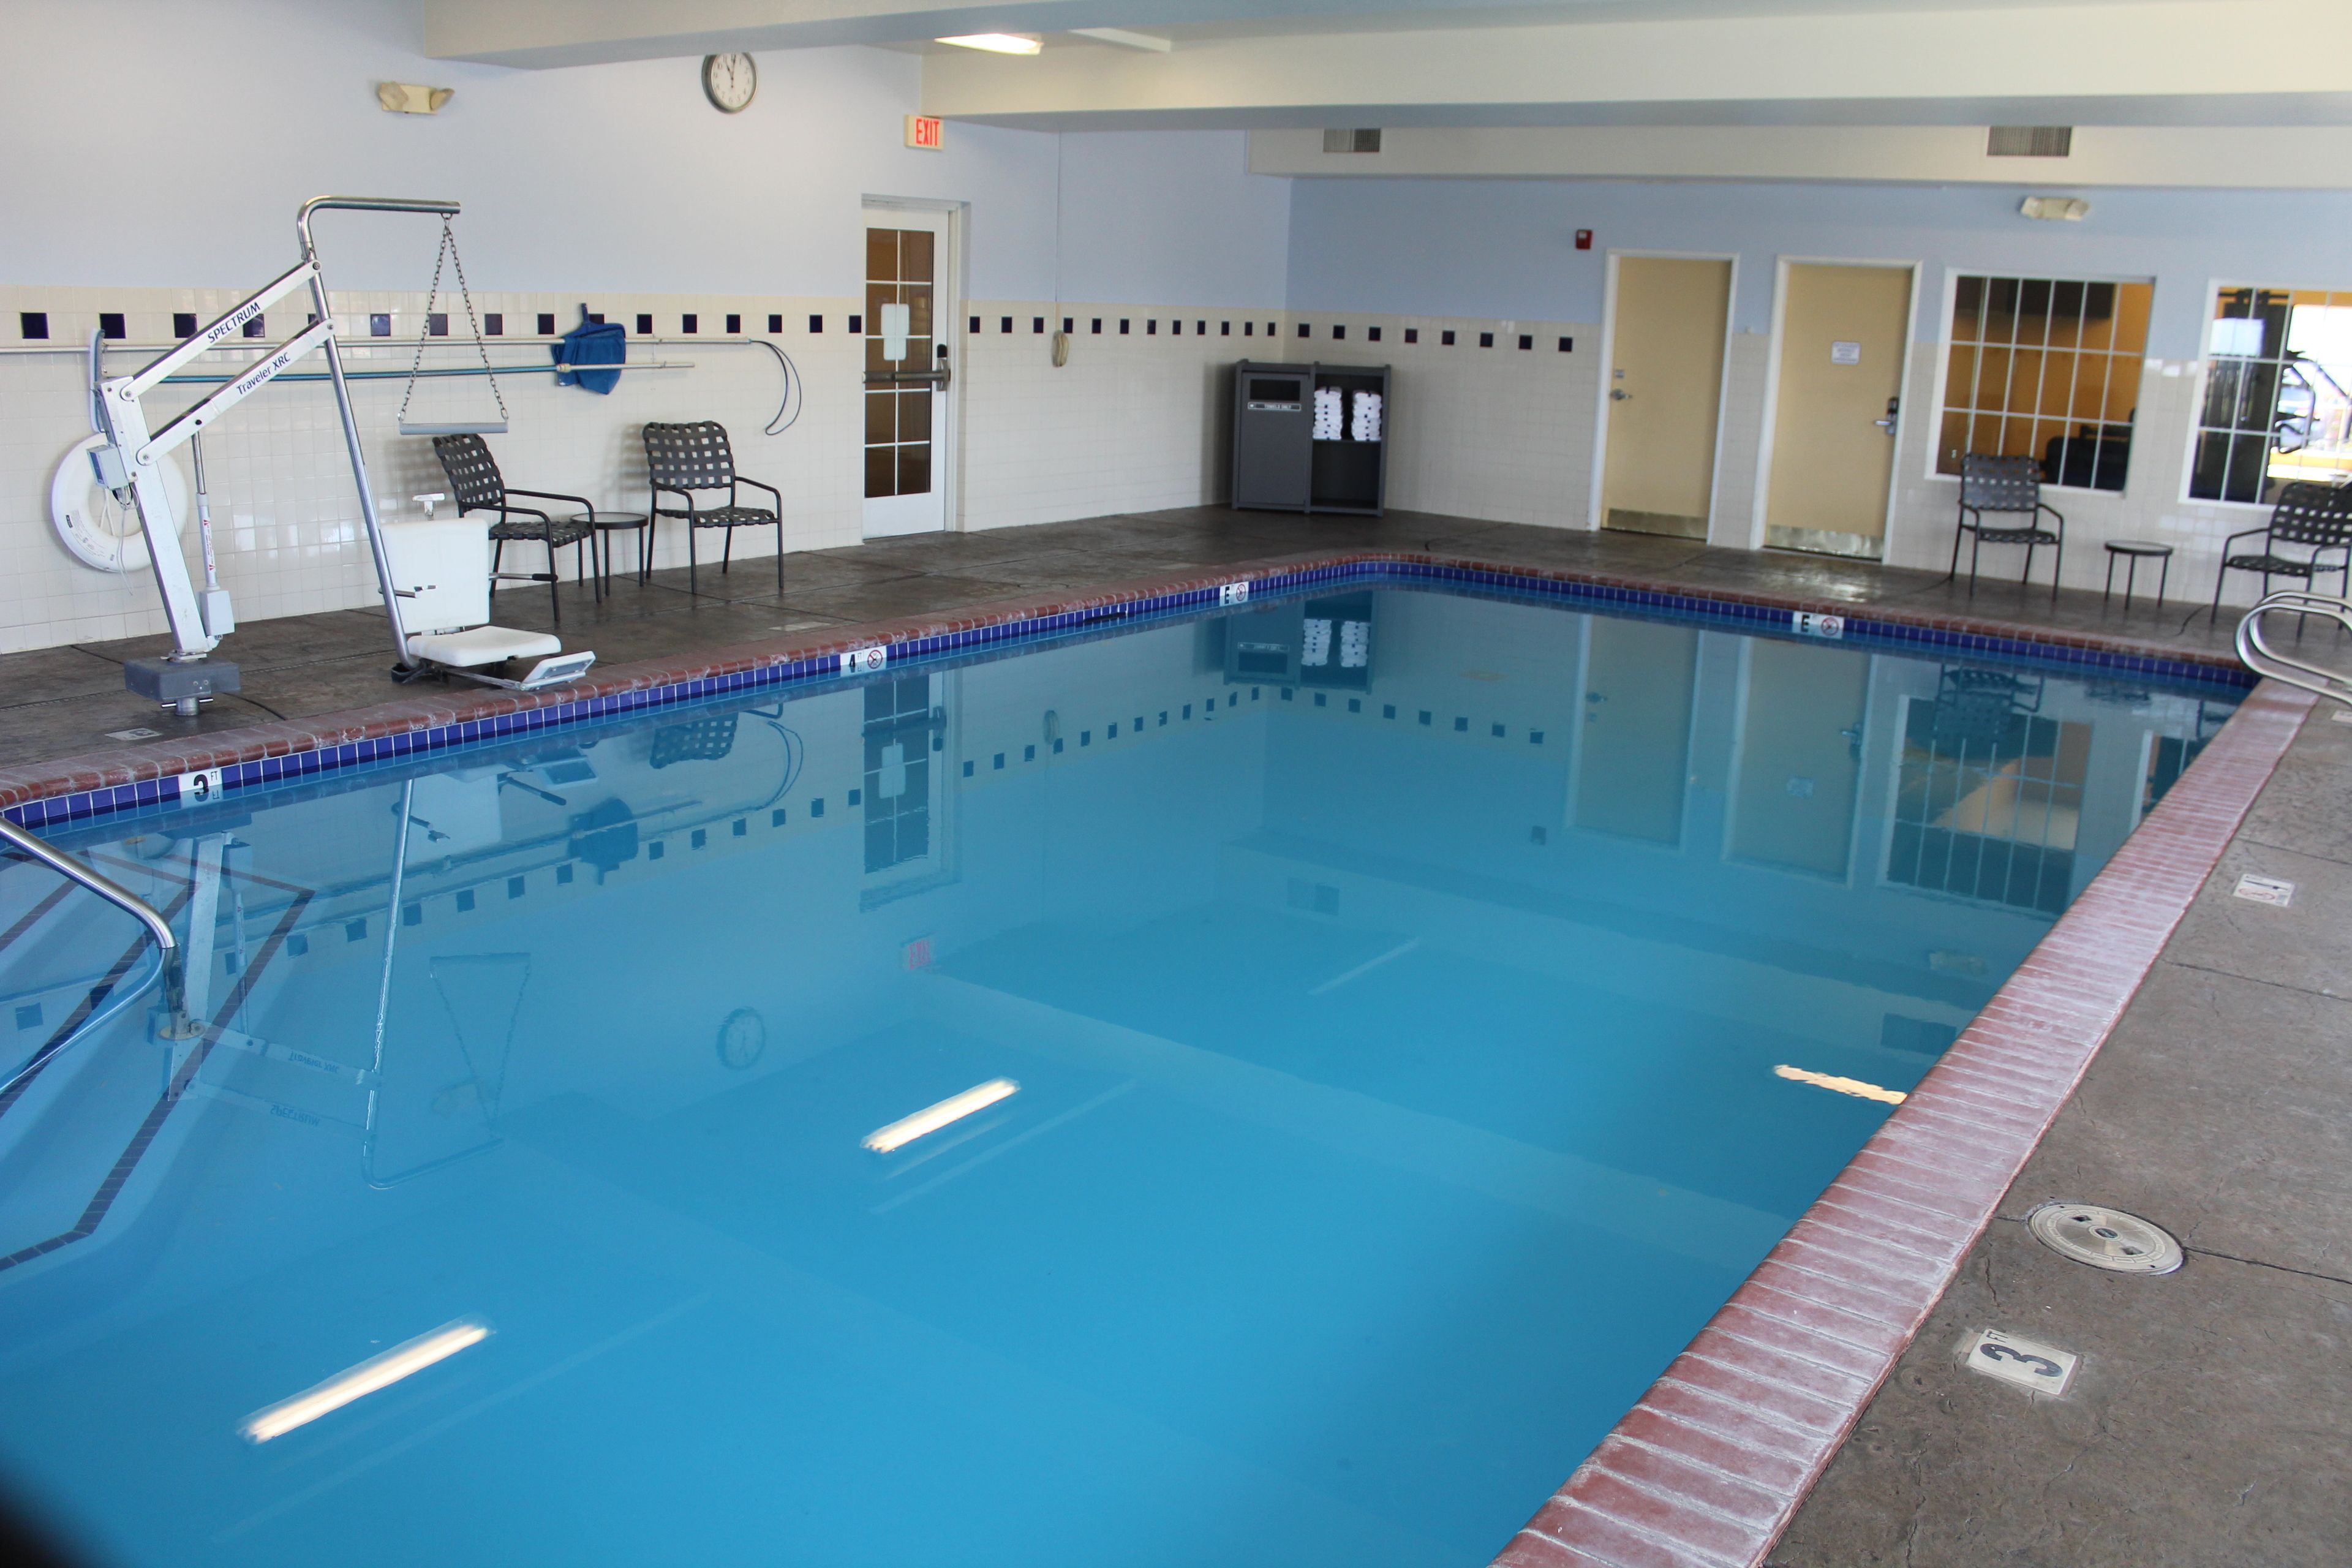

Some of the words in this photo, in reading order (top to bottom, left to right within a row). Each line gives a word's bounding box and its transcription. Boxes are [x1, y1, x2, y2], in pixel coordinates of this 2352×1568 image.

[916, 117, 940, 147] EXIT
[208, 302, 261, 344] SPECTRUM
[236, 366, 271, 395] Traveler
[273, 352, 291, 371] XRC
[194, 774, 209, 800] 3
[211, 771, 218, 781] FT
[1986, 1330, 2008, 1343] FT
[1980, 1343, 2063, 1377] 3
